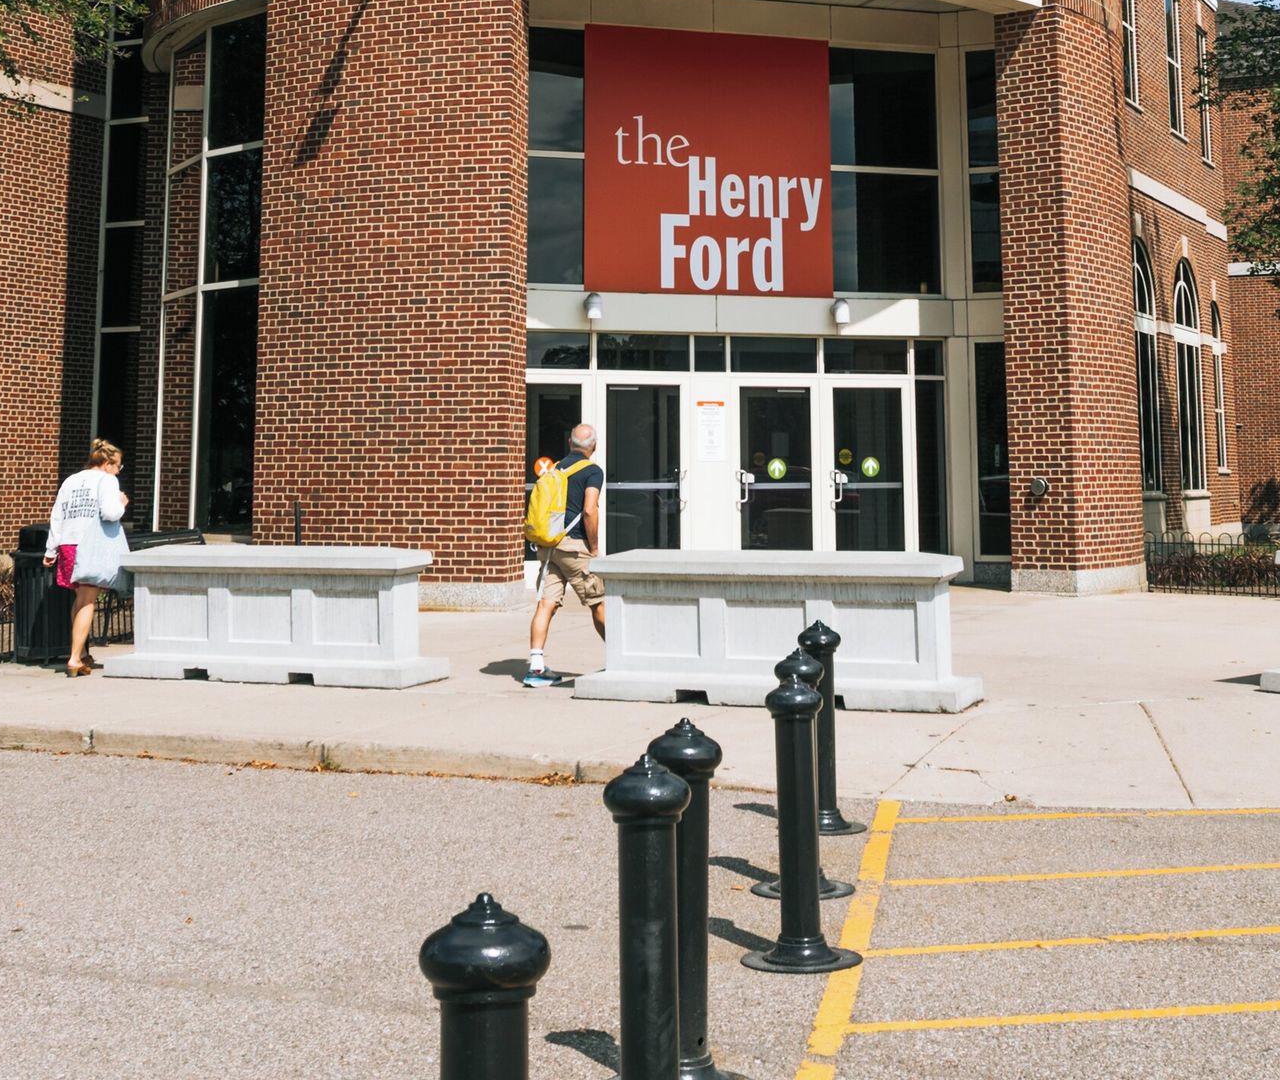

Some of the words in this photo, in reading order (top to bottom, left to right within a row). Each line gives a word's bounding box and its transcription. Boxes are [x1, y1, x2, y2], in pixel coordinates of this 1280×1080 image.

[615, 115, 690, 168] the
[688, 155, 823, 232] Henry
[660, 213, 784, 292] Ford
